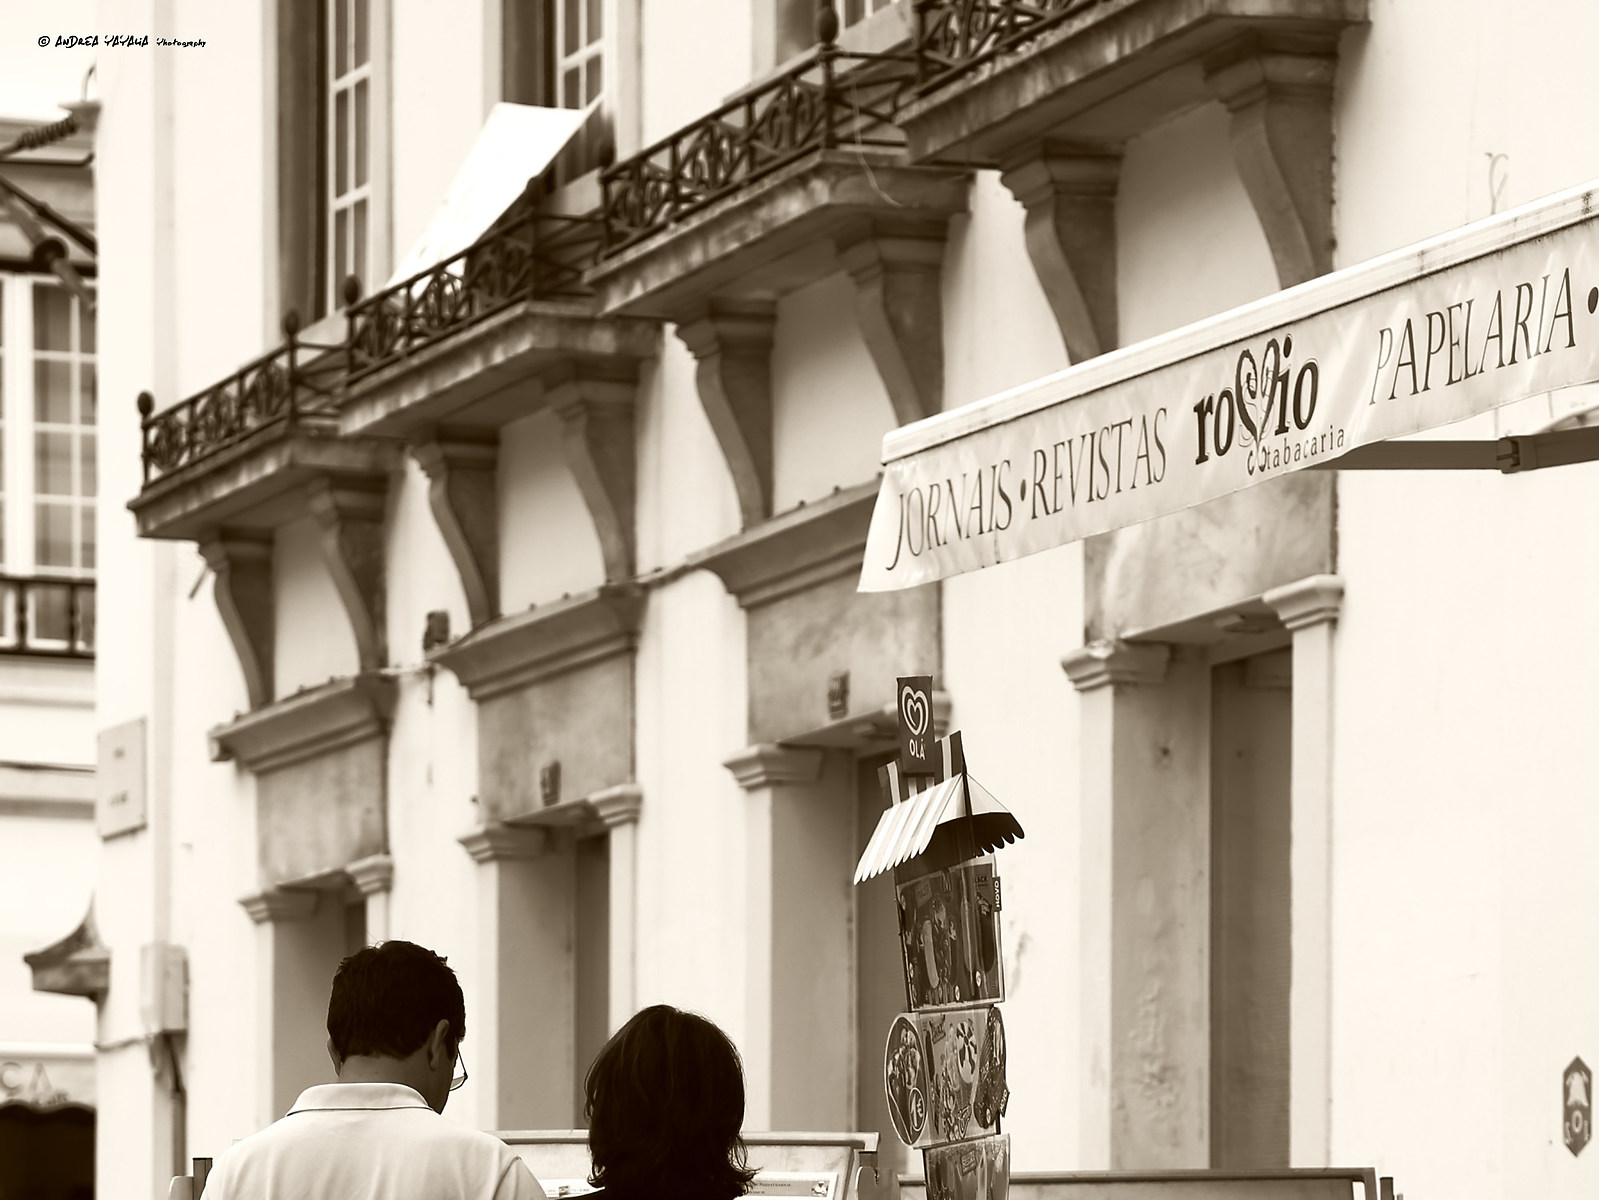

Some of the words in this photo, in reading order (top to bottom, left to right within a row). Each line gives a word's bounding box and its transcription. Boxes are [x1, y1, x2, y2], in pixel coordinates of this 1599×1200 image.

[1369, 267, 1576, 406] PAPELARIA
[886, 459, 1012, 571] JORNAIS
[1031, 407, 1168, 520] REVISTAS
[1266, 424, 1345, 470] tabacaria
